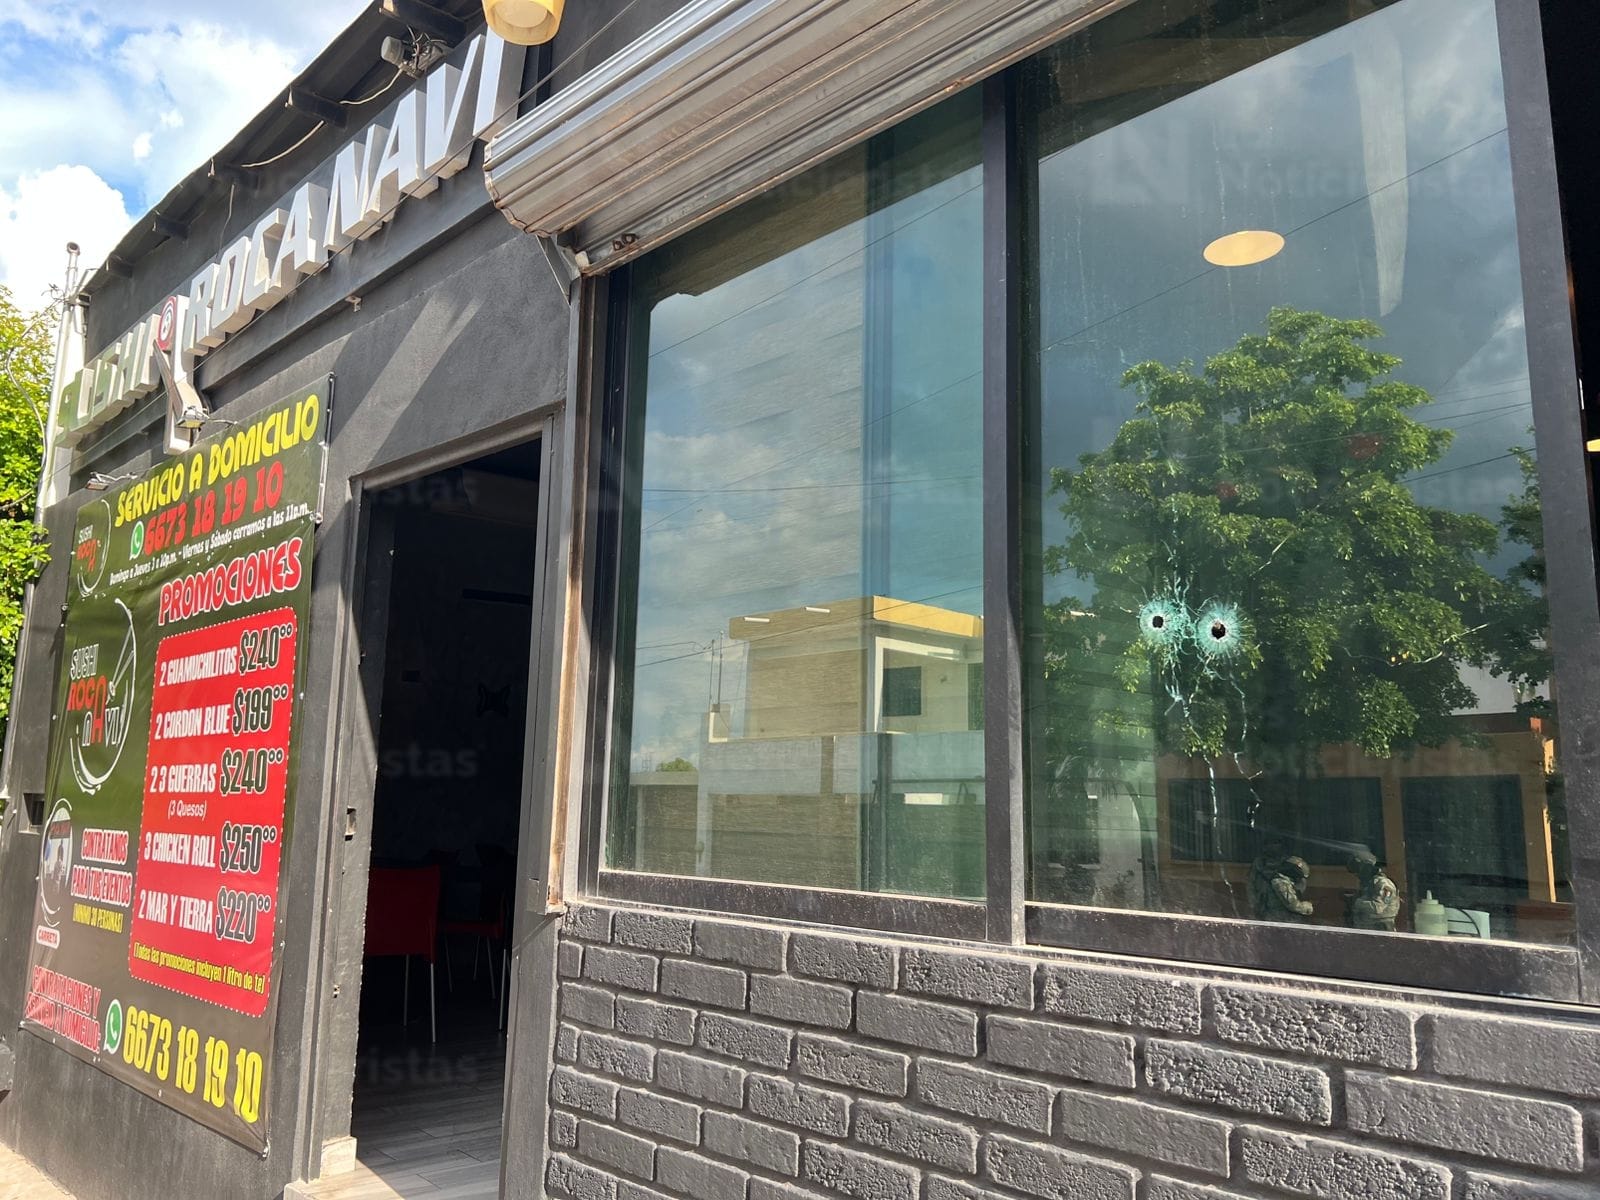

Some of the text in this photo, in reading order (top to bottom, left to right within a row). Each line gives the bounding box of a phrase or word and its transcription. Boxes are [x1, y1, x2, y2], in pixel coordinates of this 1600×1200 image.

[114, 394, 319, 527] SERVICIO A DOMICILIO
[143, 461, 284, 555] 6673 18 19 10
[182, 541, 204, 560] Viernes
[204, 541, 210, 553] y
[233, 520, 265, 541] cerramos
[266, 517, 272, 529] a
[272, 510, 285, 526] las
[158, 537, 303, 626] PROMOCIONES
[159, 661, 166, 687] 2
[167, 646, 237, 685] GUAMUCHILITOS
[154, 712, 162, 740] 2
[162, 708, 202, 740] CORDON
[203, 703, 232, 736] BLUE
[150, 765, 157, 793] 2
[158, 766, 166, 793] 3
[167, 763, 217, 793] GUERRAS
[168, 800, 207, 821] (3 Quesos)
[144, 832, 151, 860] 3
[152, 831, 190, 866] CHICKEN
[191, 835, 216, 868] ROLL
[138, 893, 146, 920] 2
[147, 891, 168, 927] MAR
[169, 894, 179, 924] Y
[179, 896, 214, 934] TIERRA
[133, 941, 151, 961] (Todas
[151, 946, 160, 964] las
[160, 951, 196, 975] promociones
[196, 958, 222, 982] incluyen
[222, 965, 227, 984] 1
[226, 964, 243, 988] litro
[243, 971, 253, 990] de
[122, 1005, 263, 1124] 6673 18 19 10
